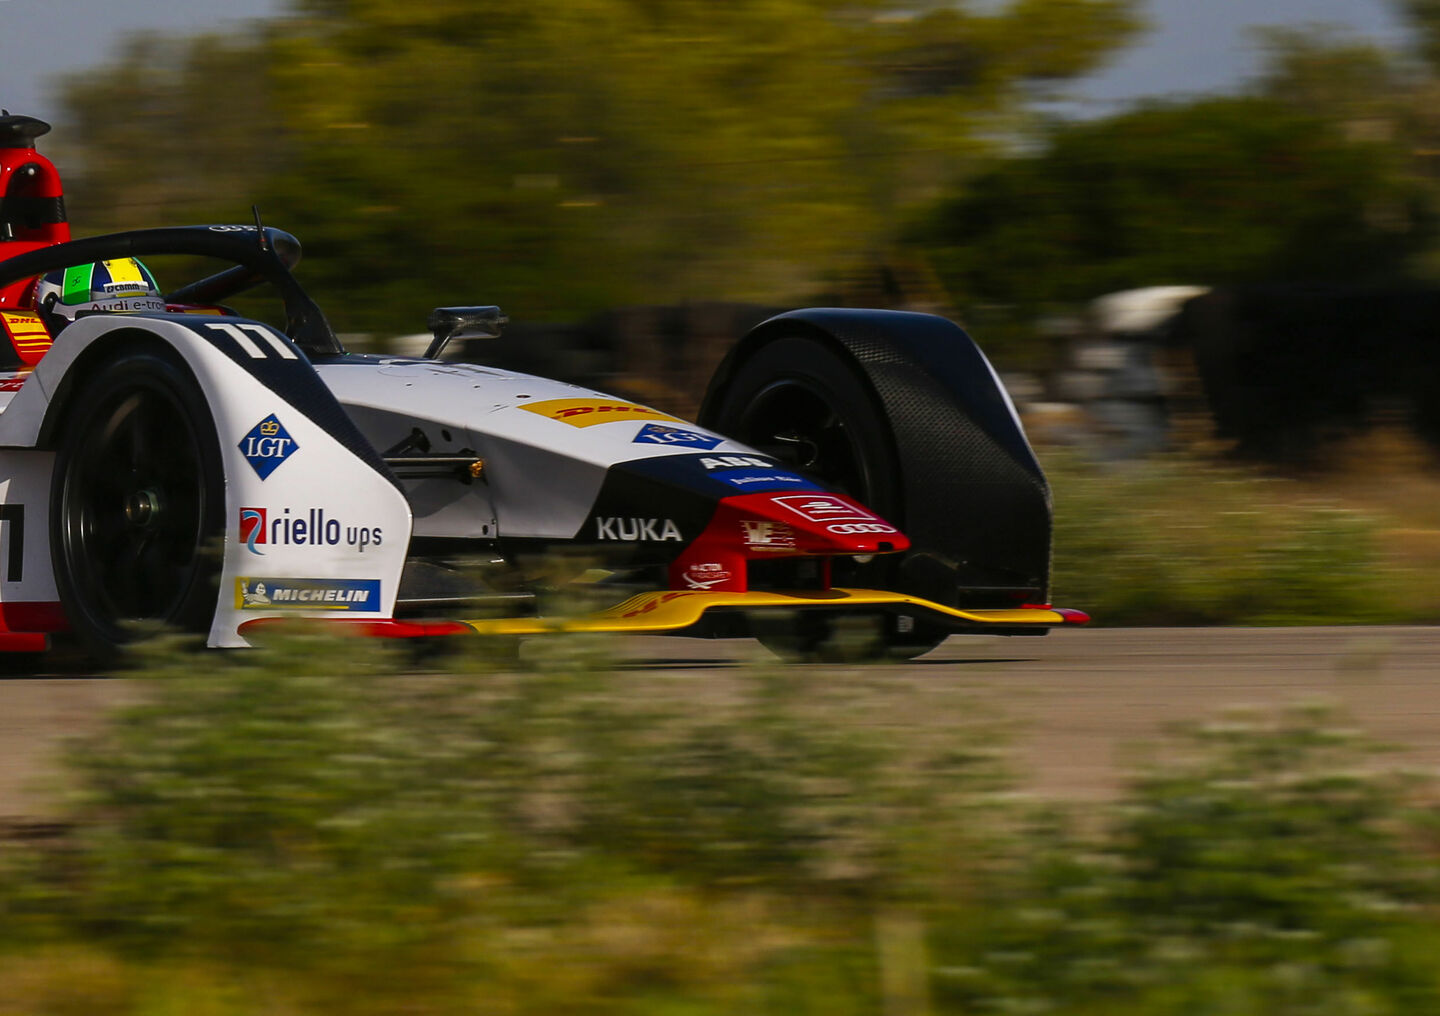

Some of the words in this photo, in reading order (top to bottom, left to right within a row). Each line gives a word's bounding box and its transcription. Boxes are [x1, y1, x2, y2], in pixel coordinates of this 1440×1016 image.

[92, 300, 128, 311] Audi
[205, 322, 299, 360] 11
[556, 406, 662, 418] DHL
[246, 437, 291, 458] LGT
[271, 508, 340, 546] riello
[347, 527, 383, 552] ups
[596, 517, 683, 541] KUKA
[273, 588, 369, 603] MICHELIN
